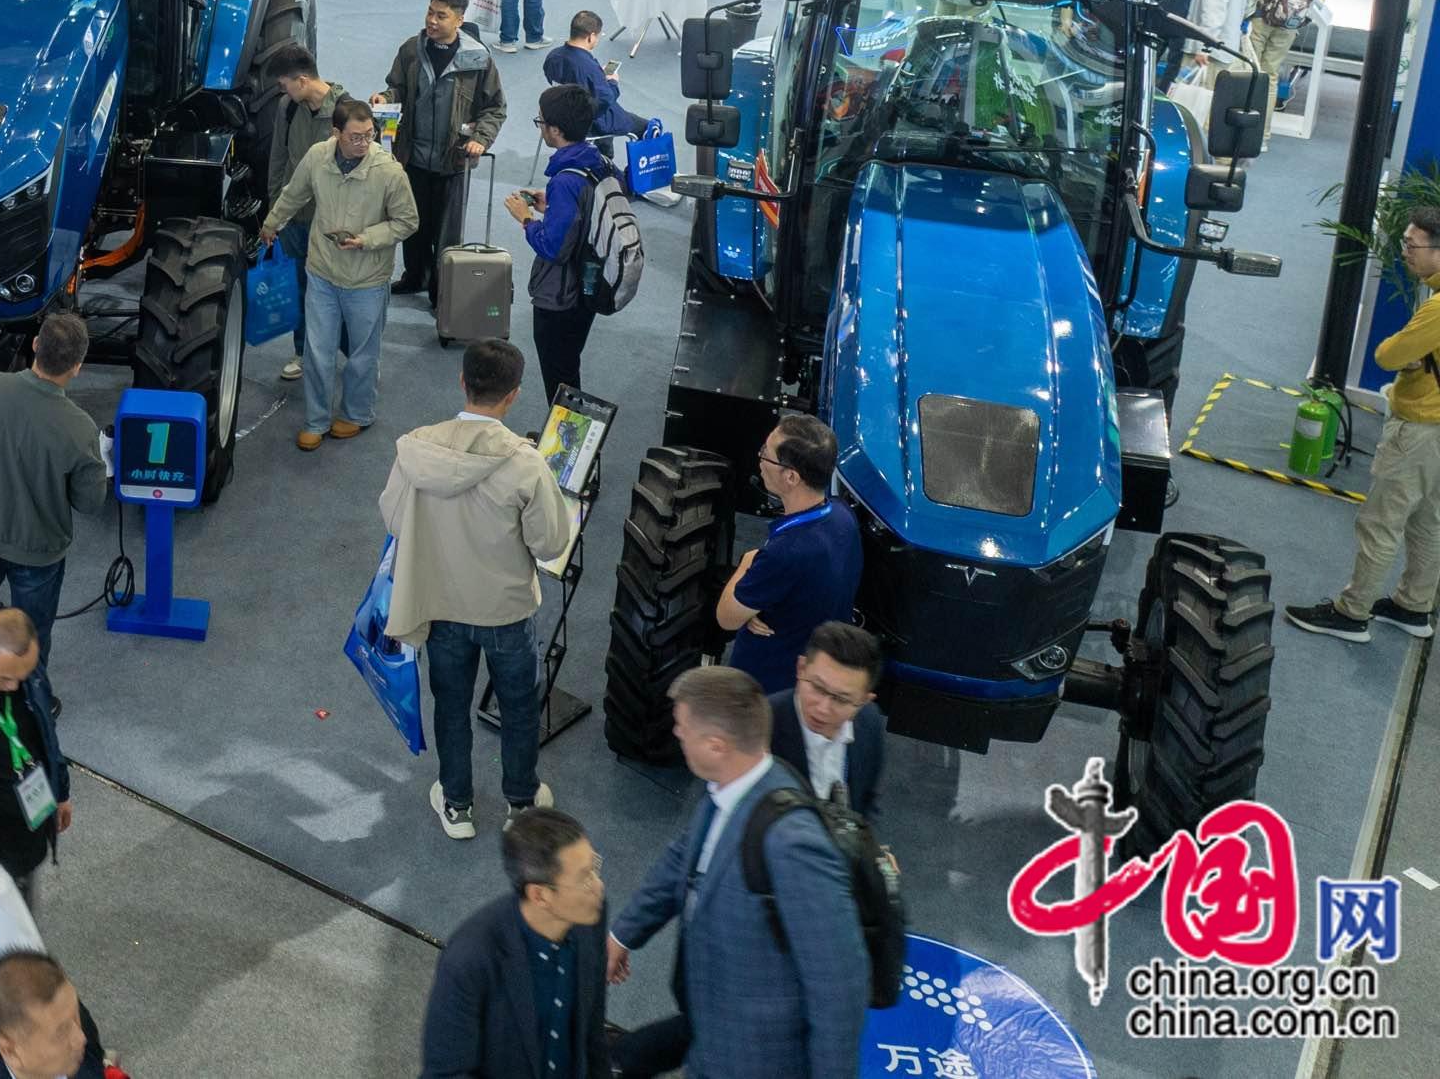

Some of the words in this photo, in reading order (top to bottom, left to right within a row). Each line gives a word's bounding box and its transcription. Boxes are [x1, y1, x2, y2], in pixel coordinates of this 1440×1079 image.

[147, 422, 170, 464] 1
[131, 469, 184, 482] 小时快充
[877, 1043, 979, 1079] 万途
